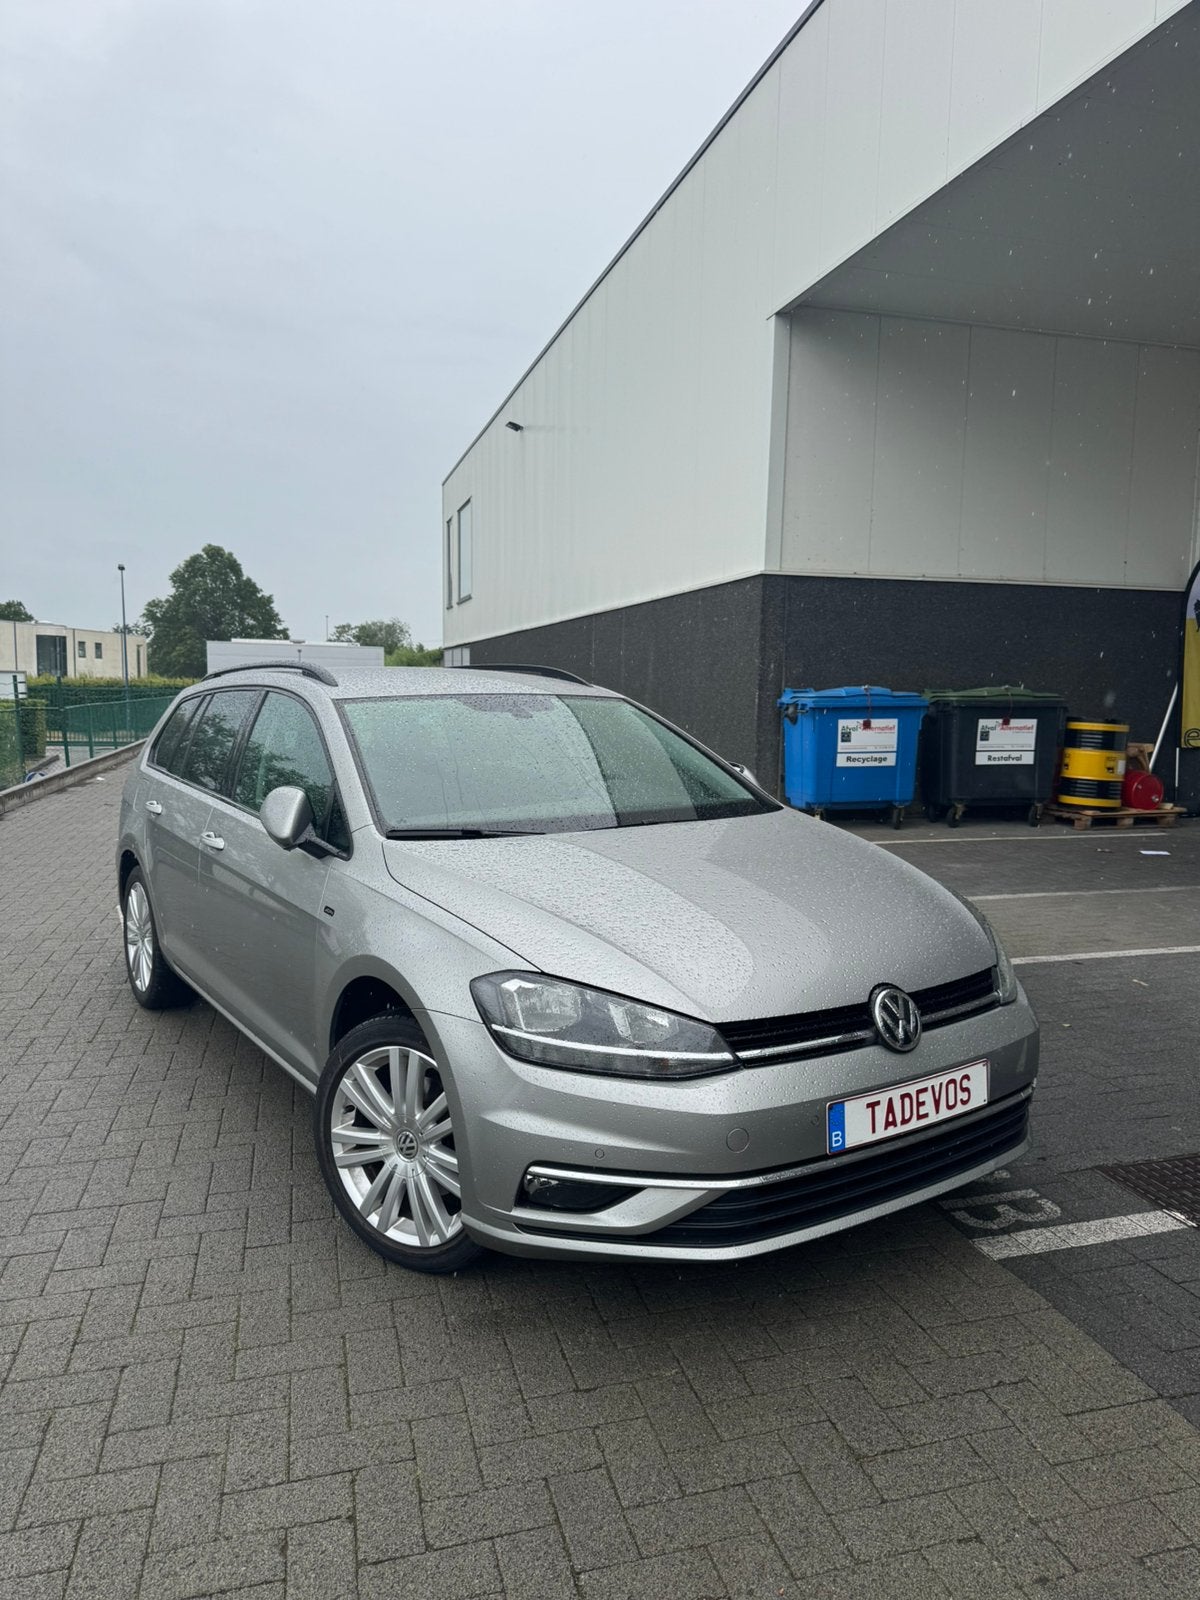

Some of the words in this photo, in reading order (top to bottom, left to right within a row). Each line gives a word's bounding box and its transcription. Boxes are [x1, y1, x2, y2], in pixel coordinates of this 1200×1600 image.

[846, 754, 888, 765] Recyclage
[987, 753, 1022, 762] Restafval
[866, 1073, 972, 1134] TADEVOS
[832, 1131, 843, 1147] B
